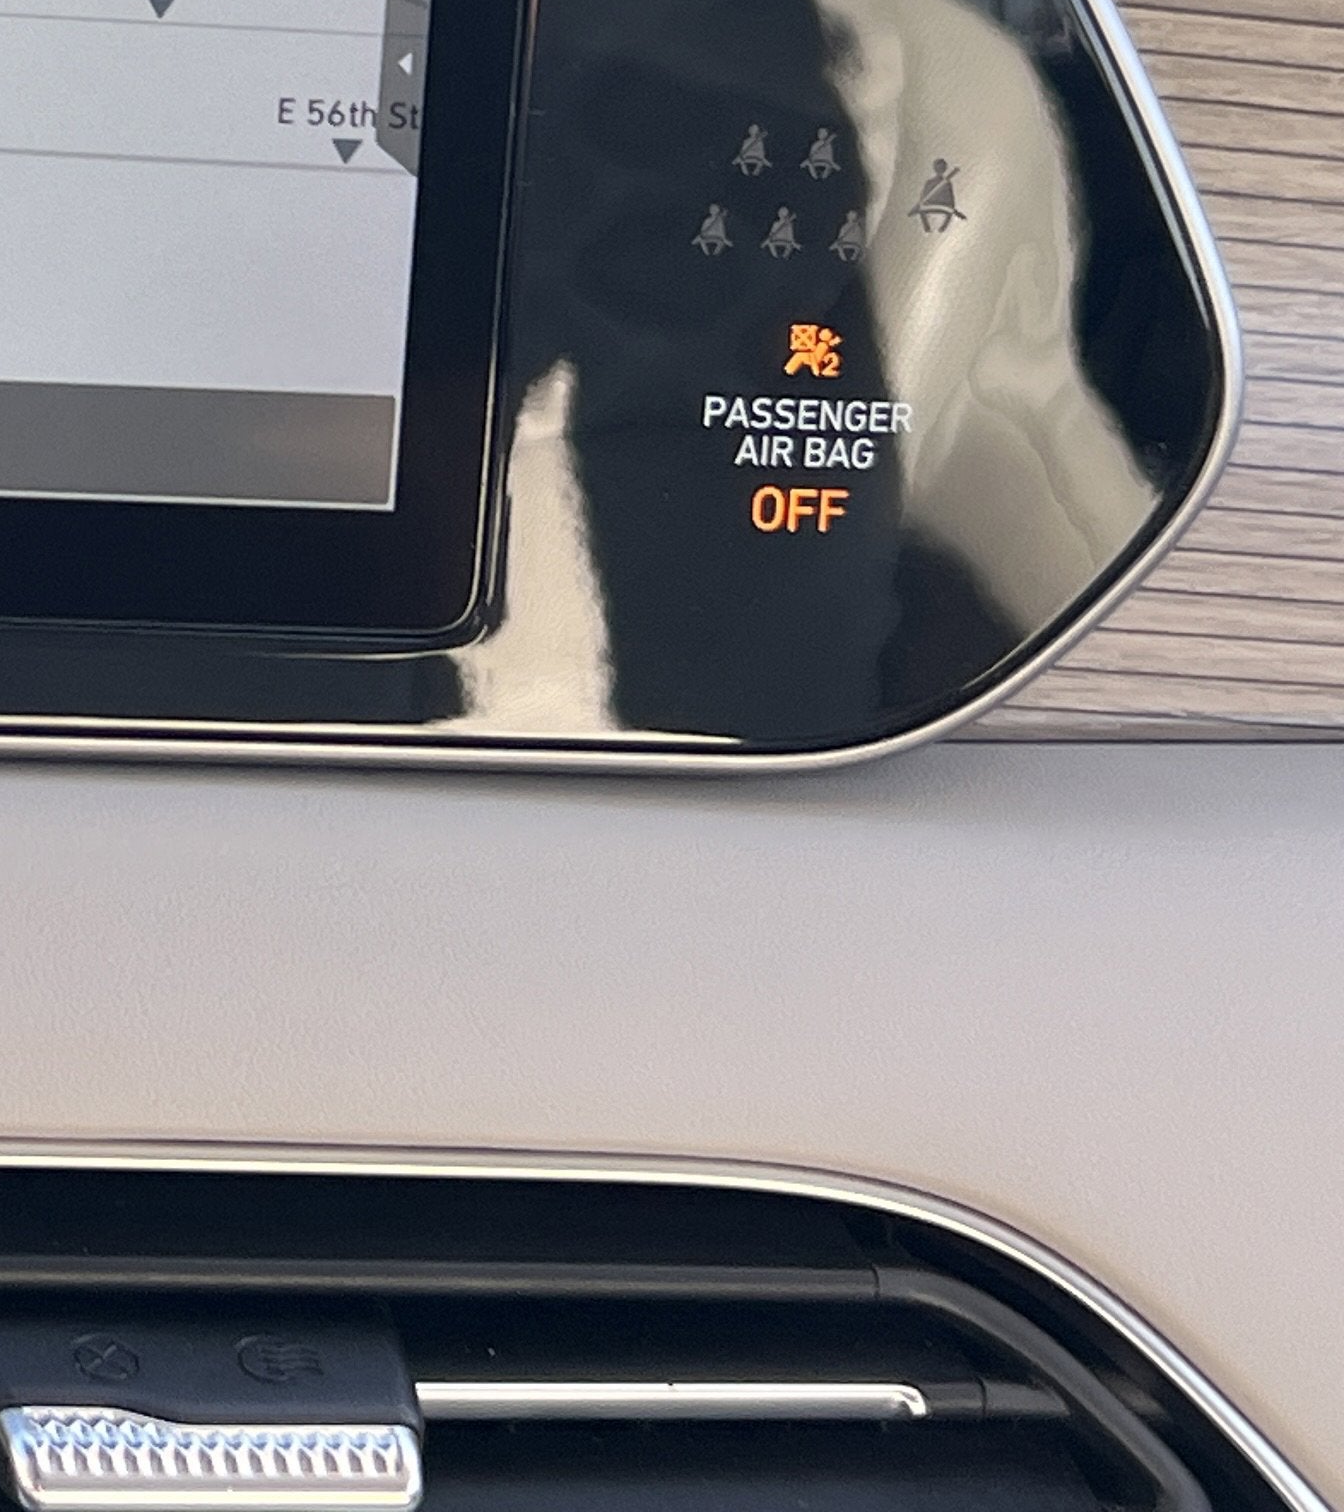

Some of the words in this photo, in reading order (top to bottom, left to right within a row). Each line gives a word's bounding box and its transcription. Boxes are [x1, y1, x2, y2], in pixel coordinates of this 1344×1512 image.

[277, 98, 295, 125] E
[307, 99, 378, 128] 56th
[388, 102, 420, 130] St
[703, 395, 912, 433] PASSENGER
[734, 435, 793, 467] AIR
[804, 437, 874, 469] BAG
[752, 485, 850, 532] OFF
